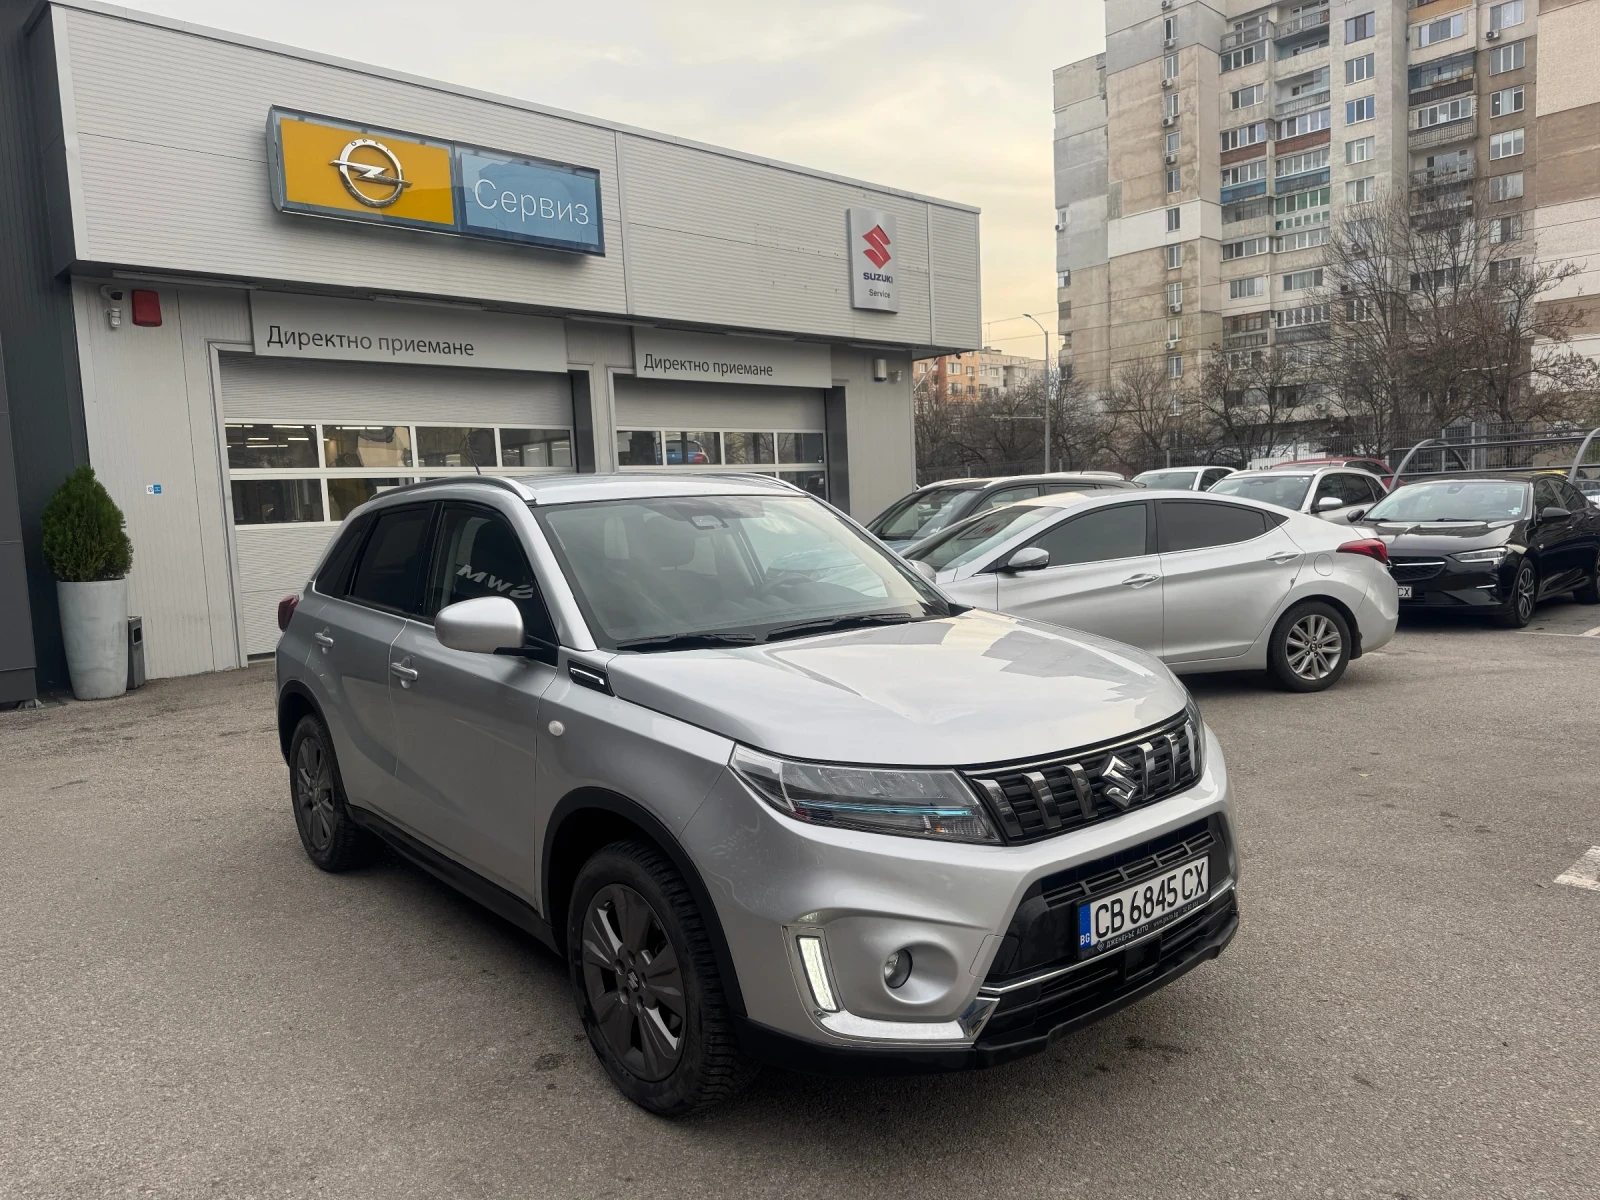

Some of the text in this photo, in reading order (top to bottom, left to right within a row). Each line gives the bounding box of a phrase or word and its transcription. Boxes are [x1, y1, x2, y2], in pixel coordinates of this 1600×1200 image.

[474, 178, 589, 225] Сервиз
[863, 272, 893, 284] SUZUKI
[868, 288, 891, 299] Service
[267, 325, 474, 356] Директно приемане
[644, 353, 773, 377] Директно приемане
[1129, 874, 1178, 924] 6845
[1080, 933, 1091, 946] BG
